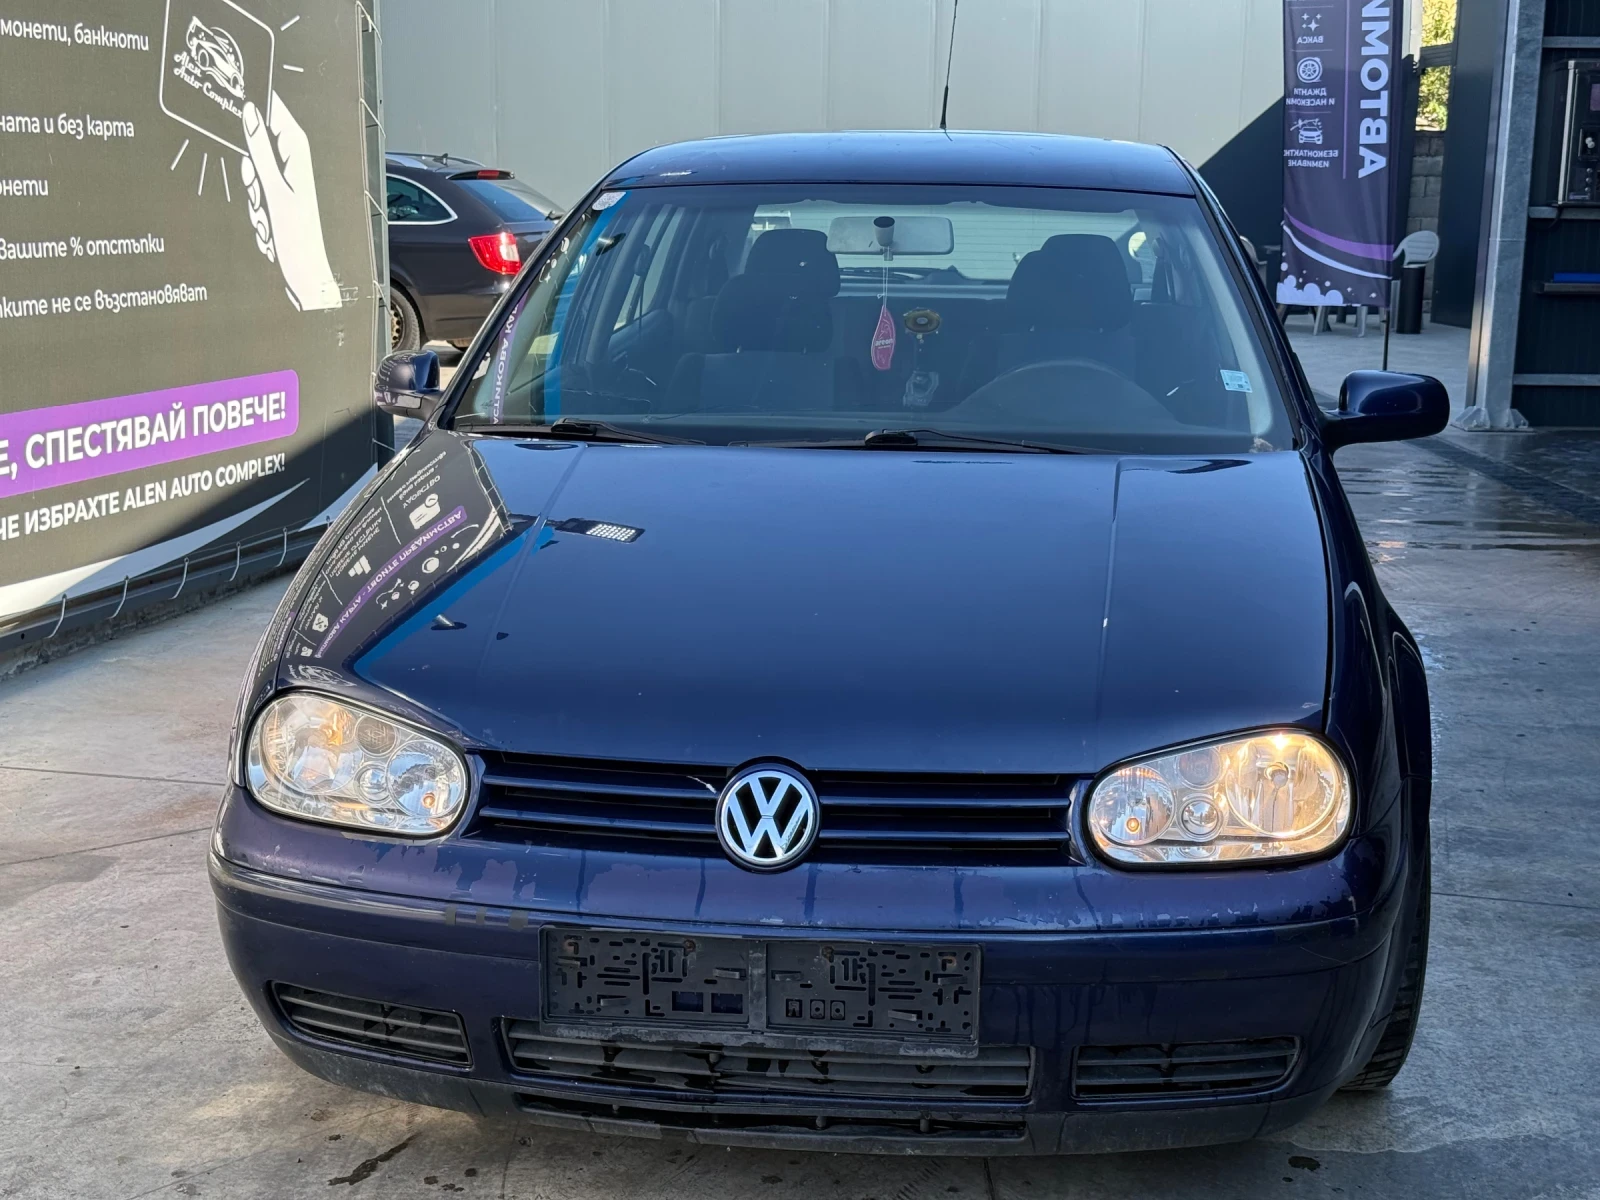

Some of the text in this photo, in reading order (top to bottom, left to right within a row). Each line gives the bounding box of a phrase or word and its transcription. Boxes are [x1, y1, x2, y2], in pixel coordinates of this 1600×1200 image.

[1, 18, 149, 51] монети, банкноти
[173, 51, 203, 77] Alen
[173, 66, 243, 118] Auto Complex
[44, 117, 54, 134] и
[58, 112, 84, 140] без
[87, 114, 134, 141] карта
[70, 236, 84, 257] %
[86, 233, 164, 257] отстъпки
[52, 296, 71, 314] не
[74, 294, 92, 312] се
[95, 283, 207, 313] възстановяват
[25, 402, 186, 469] СПЕСТЯВАЙ
[193, 391, 286, 437] ПОВЕЧЕ!
[24, 491, 120, 534] ИЗБРАХТЕ
[123, 481, 167, 511] ALEN
[170, 471, 212, 500] AUTO
[215, 452, 286, 488] COMPLEX!
